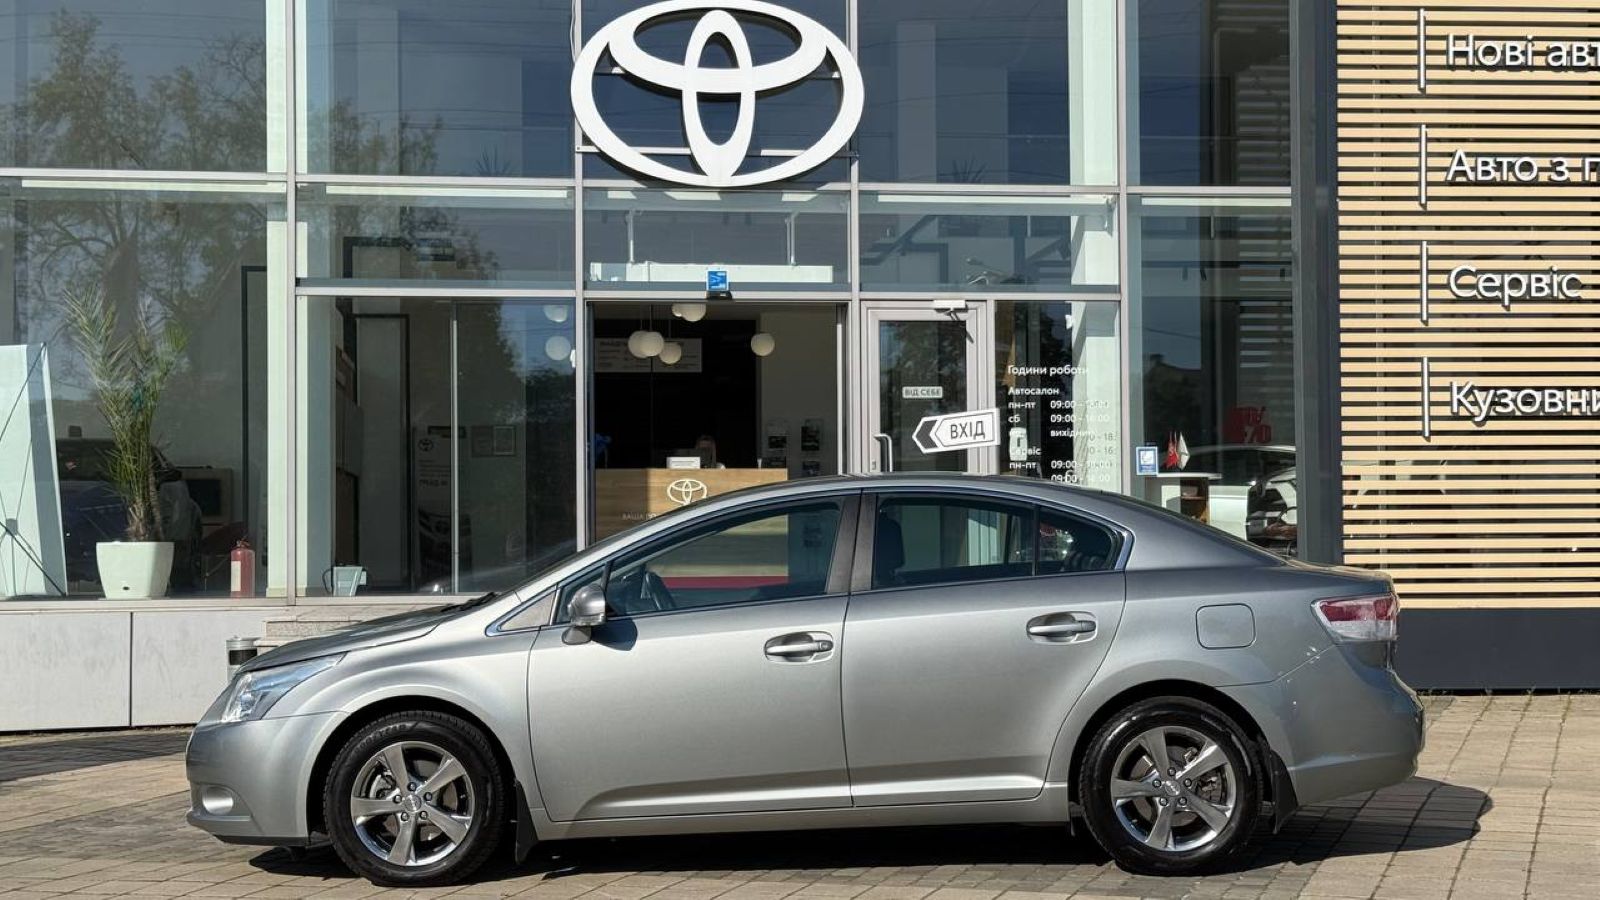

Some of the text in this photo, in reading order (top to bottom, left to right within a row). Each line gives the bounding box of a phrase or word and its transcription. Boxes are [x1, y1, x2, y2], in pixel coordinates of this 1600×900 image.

[1448, 33, 1534, 67] Нові
[1446, 148, 1538, 182] Авто
[1550, 156, 1569, 182] з
[1449, 264, 1581, 306] Сервіс
[1007, 364, 1047, 377] Години
[1008, 386, 1060, 396] Автосалон
[1008, 401, 1036, 409] пн-пт
[1050, 400, 1076, 409] 09:00
[1008, 414, 1021, 423] сб
[1050, 414, 1076, 423] 09:00
[950, 420, 985, 441] ВХІД
[1051, 460, 1077, 469] 09:00
